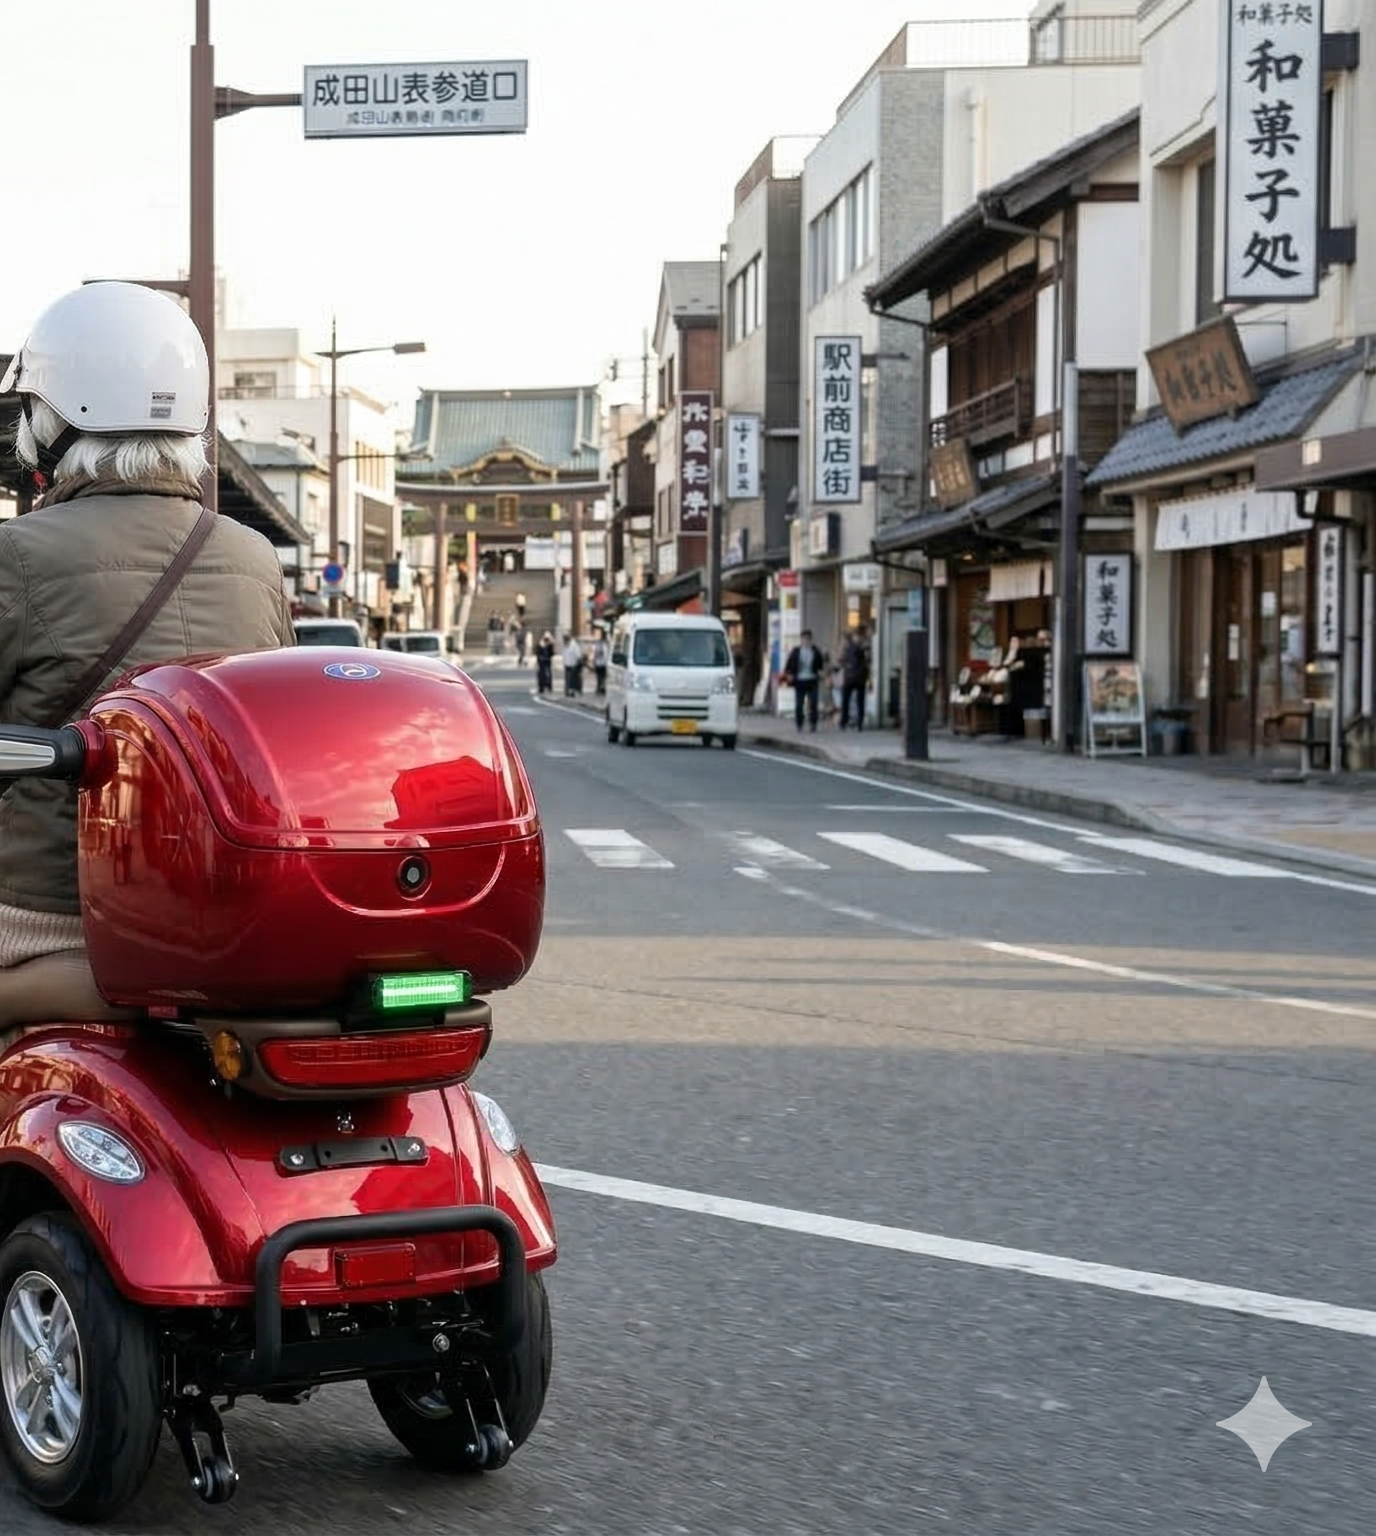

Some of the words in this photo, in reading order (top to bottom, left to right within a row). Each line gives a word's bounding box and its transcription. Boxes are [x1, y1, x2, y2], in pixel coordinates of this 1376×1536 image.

[1236, 2, 1312, 26] 和菓子処
[312, 70, 518, 107] 成田山表参道口
[1241, 38, 1304, 280] 和菓子処
[822, 343, 853, 496] 駅前商店街
[1096, 560, 1120, 648] 和菓子処
